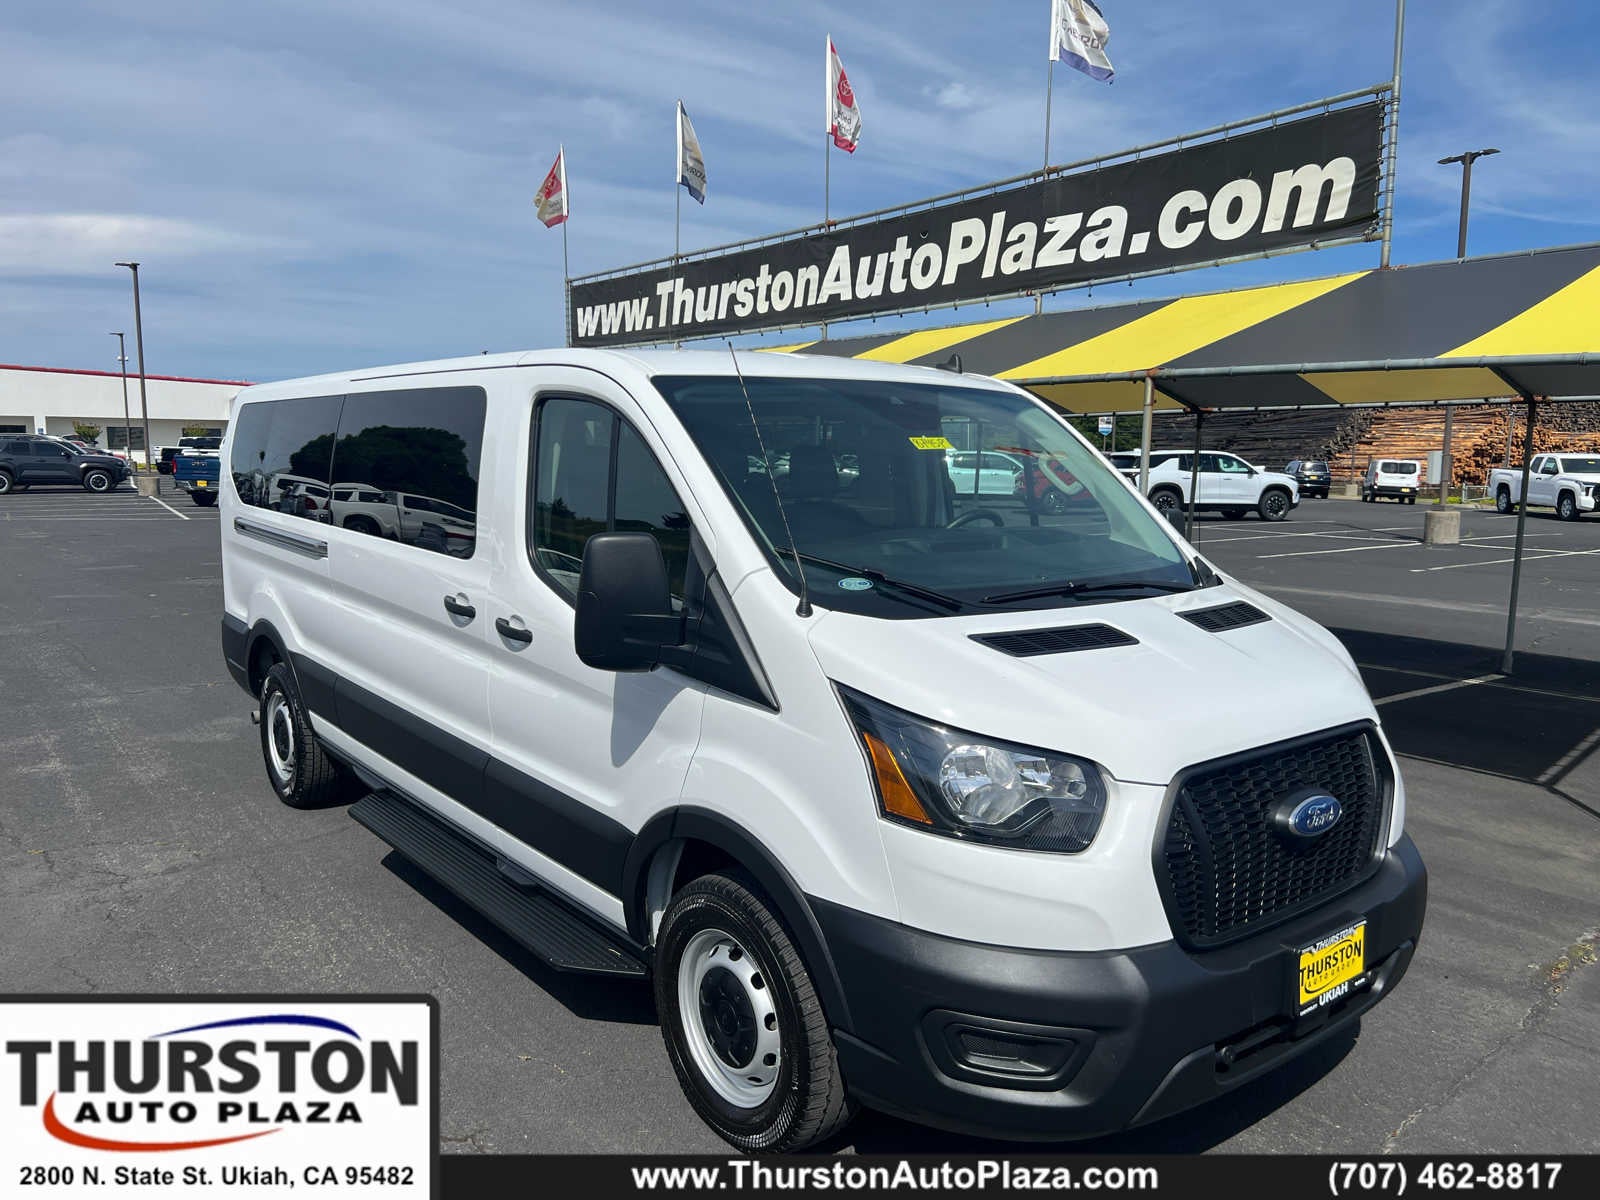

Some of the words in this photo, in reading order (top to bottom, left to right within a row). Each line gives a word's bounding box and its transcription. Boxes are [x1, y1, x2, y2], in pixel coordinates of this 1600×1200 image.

[576, 156, 1356, 338] www.ThurstonAutoPlaza.com
[1307, 803, 1335, 829] Ford
[1300, 939, 1362, 987] THURSTON
[1319, 981, 1349, 1006] UKIAH
